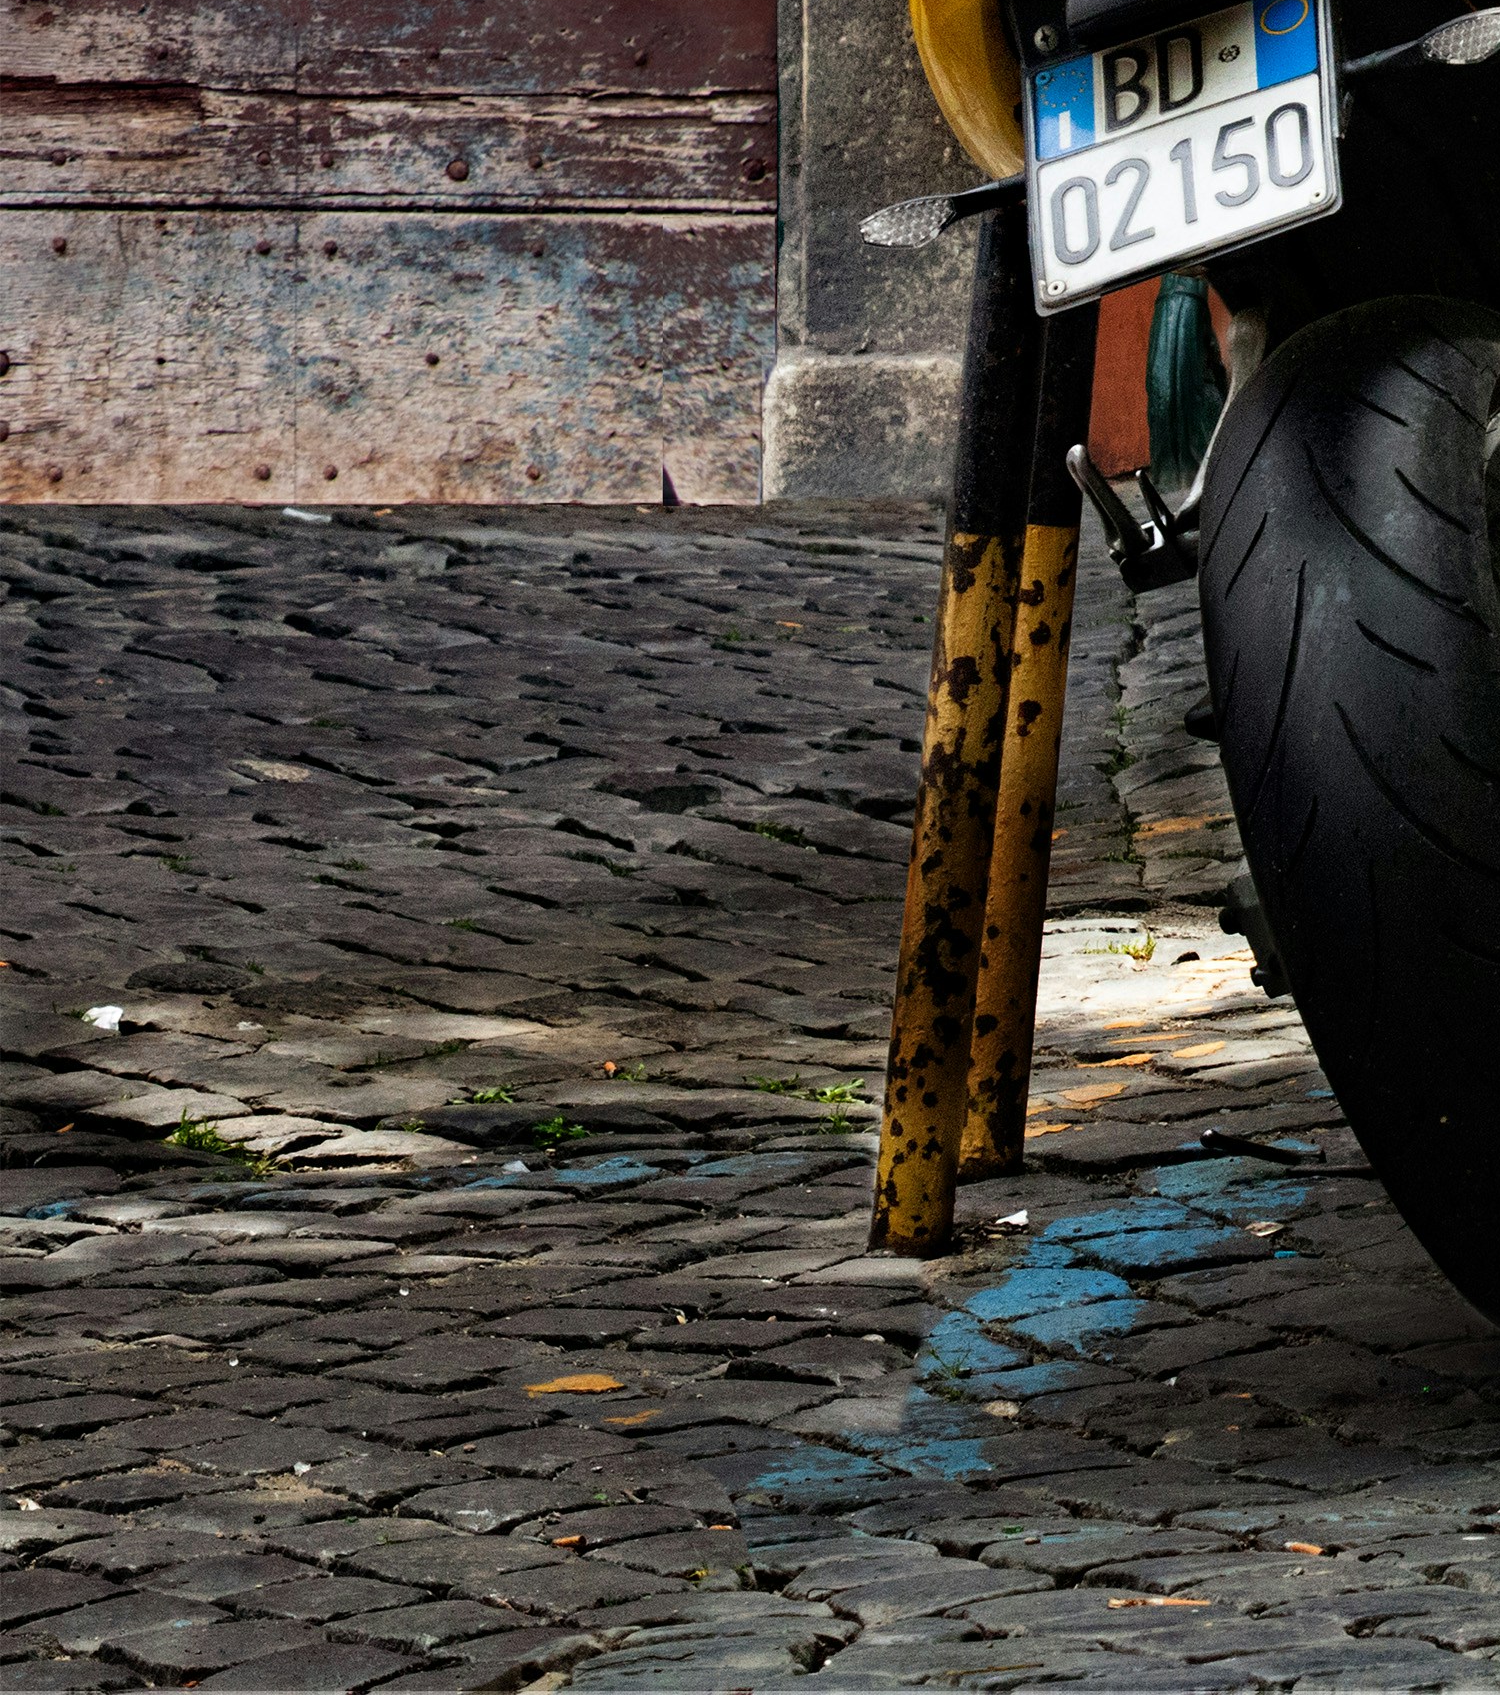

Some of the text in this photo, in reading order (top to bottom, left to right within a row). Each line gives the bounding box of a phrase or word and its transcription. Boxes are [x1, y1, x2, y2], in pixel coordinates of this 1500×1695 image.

[1059, 110, 1071, 149] I
[1102, 30, 1204, 133] BD
[1051, 101, 1315, 265] 02150
